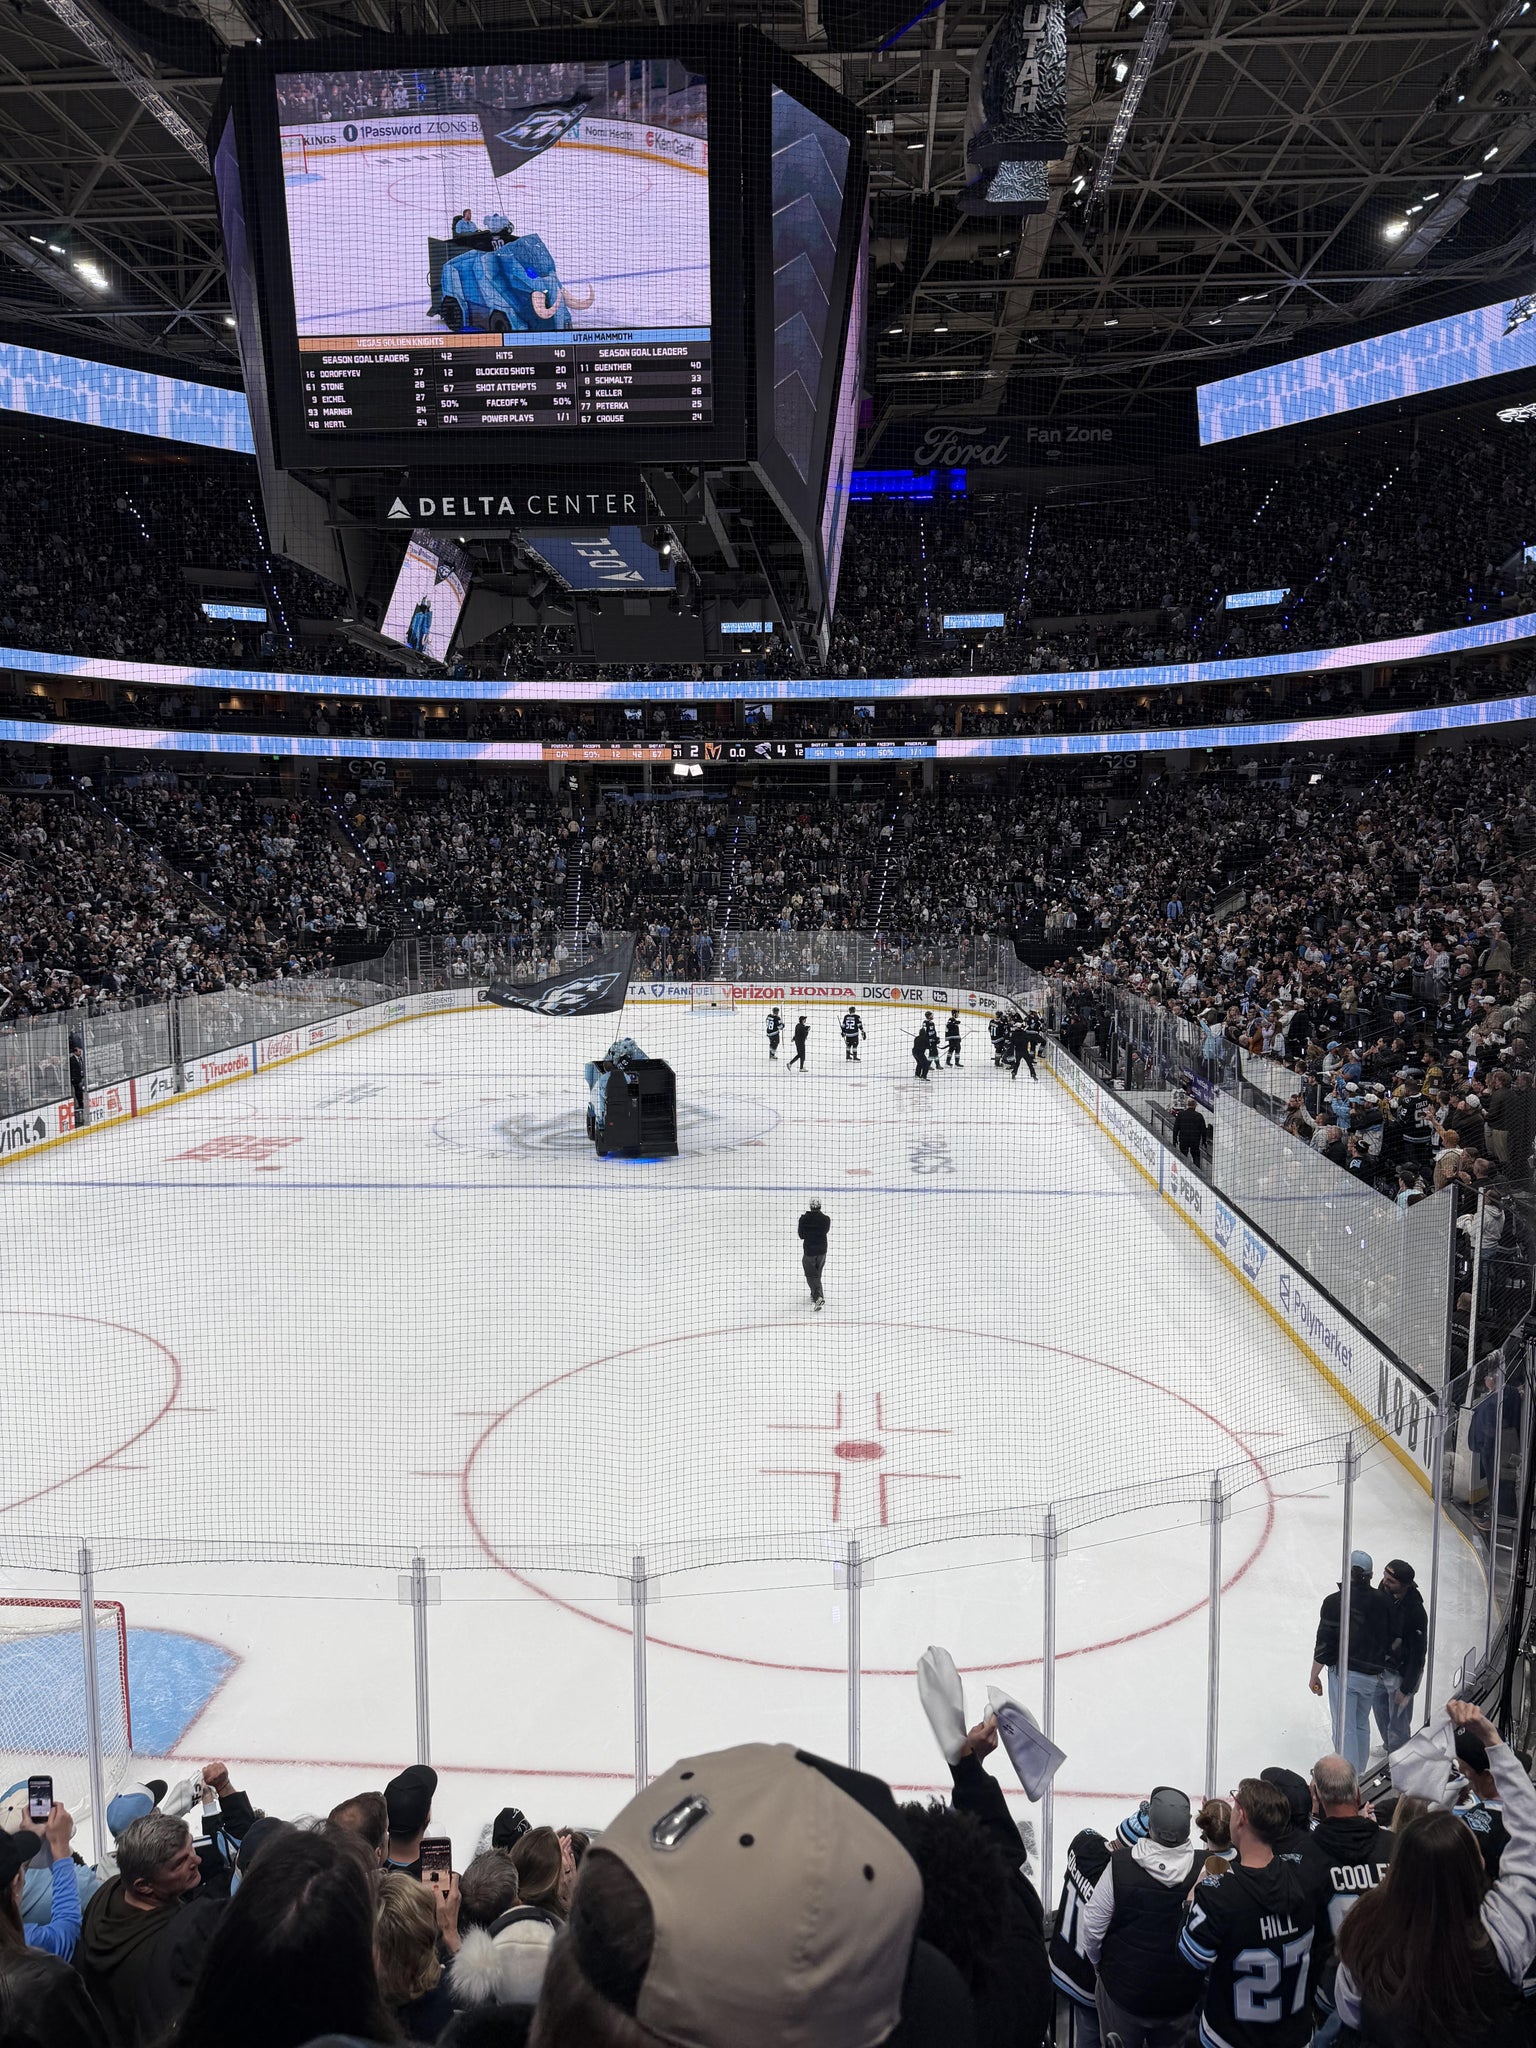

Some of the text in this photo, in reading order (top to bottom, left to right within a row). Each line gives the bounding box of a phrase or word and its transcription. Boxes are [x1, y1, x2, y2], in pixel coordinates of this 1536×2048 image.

[1012, 4, 1048, 113] UTAH
[361, 123, 422, 139] 1Password
[427, 121, 467, 134] ZIONS
[357, 337, 444, 348] VEGAS GOLDEN KNIGHTS
[572, 332, 633, 342] UTAH MAMMOTH
[441, 349, 566, 361] 42 HITS 40
[599, 347, 688, 358] SEASON GOAL LEADERS
[322, 353, 410, 365] SEASON GOAL LEADERS
[443, 365, 567, 377] 12 BLOCKED SHOTS 20
[580, 361, 702, 372] 11 GUENTHER 40
[306, 368, 424, 379] 16 DOROFEYEV 37
[584, 374, 702, 385] 8 SCHMALTZ 33
[305, 380, 425, 392] 61 STONE 28
[443, 381, 567, 393] 67 SHOT ATTEMPTS 54
[311, 393, 426, 404] 9 EICHEL 27
[585, 387, 702, 398] 9 KELLER 26
[441, 397, 572, 409] 50% FACEOFF % 50%
[580, 400, 702, 411] 77 PETERKA 25
[307, 405, 427, 417] 93 MARNER 24
[308, 418, 428, 429] 48 HERTL 24
[443, 412, 570, 424] 0/4 POWER PLAYS 1/1
[581, 413, 703, 424] 67 CROUSE 24
[1026, 425, 1113, 444] Fan Zone
[914, 425, 1011, 466] Ford
[419, 493, 637, 516] DELTA CENTER
[690, 745, 699, 757] 2
[729, 748, 746, 758] 0.0
[776, 744, 787, 756] 4
[877, 748, 894, 756] 50%
[721, 984, 785, 999] verizon
[789, 986, 856, 997] HONDA
[862, 986, 923, 1001] DISCOVER
[979, 997, 998, 1010] PEPSI
[1180, 1175, 1202, 1216] PEPSI
[1293, 1289, 1353, 1374] Polymarket
[1330, 1862, 1391, 1891] COOLE
[1259, 1913, 1299, 1941] HILL
[1233, 1923, 1316, 2024] 27
